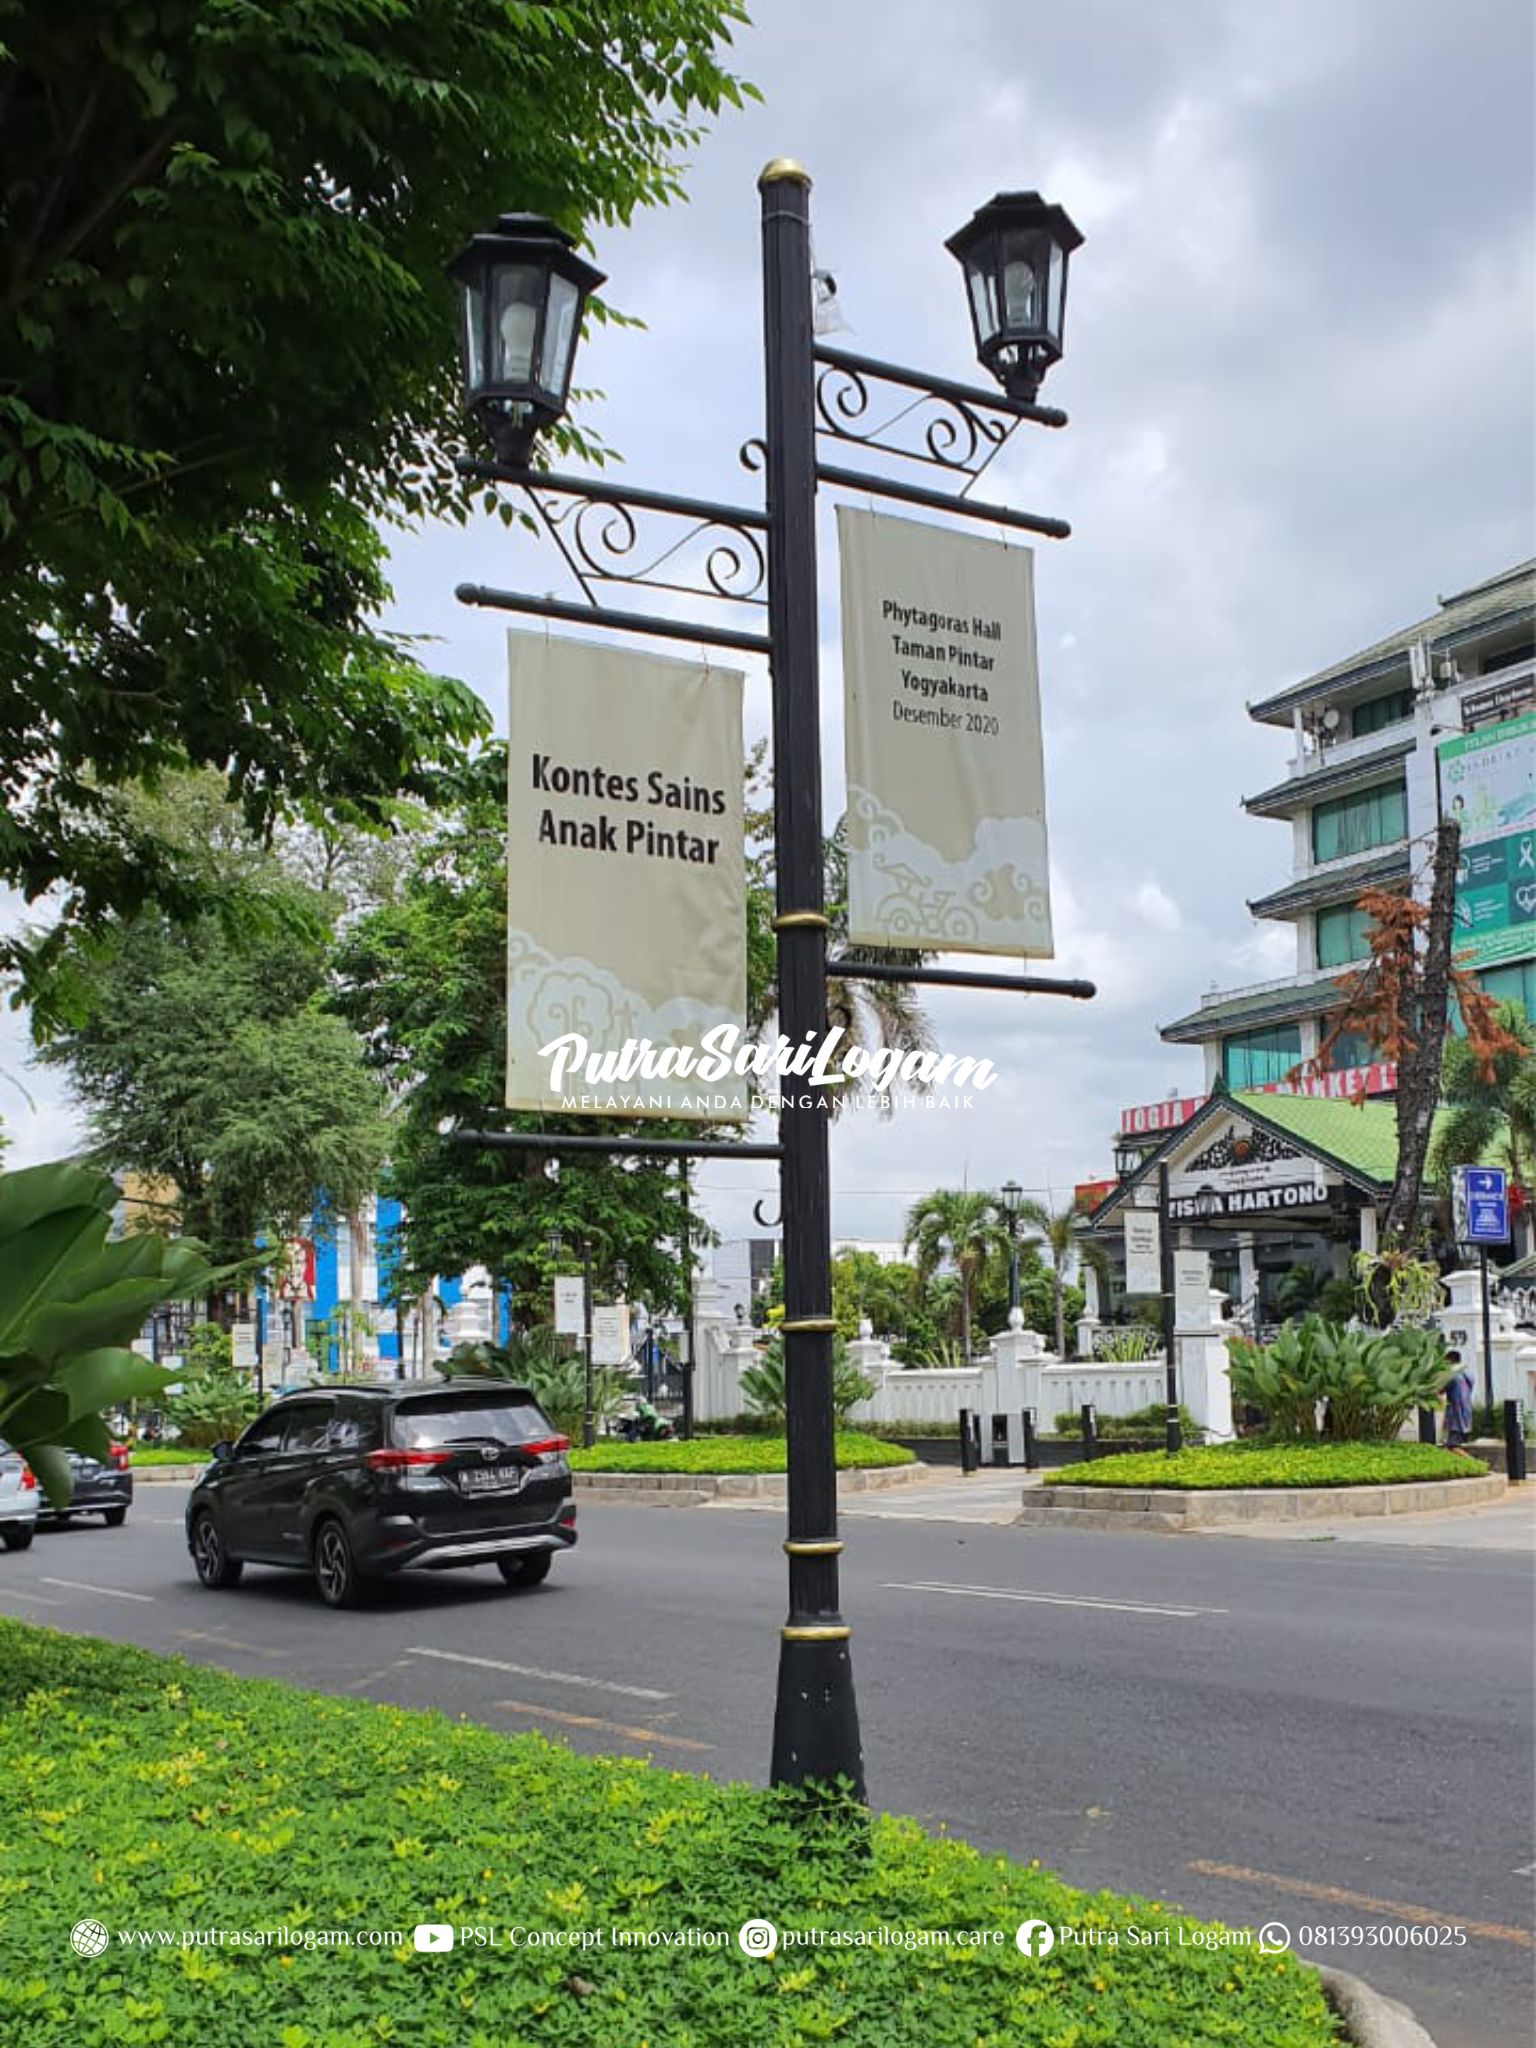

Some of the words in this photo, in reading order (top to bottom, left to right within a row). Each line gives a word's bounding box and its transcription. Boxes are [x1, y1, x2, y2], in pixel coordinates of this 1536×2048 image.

[882, 600, 970, 634] Phytagoras
[972, 617, 1002, 641] Hall
[892, 635, 946, 661] Taman
[948, 645, 996, 673] Pintar
[901, 668, 989, 703] Yogyakarta
[892, 699, 963, 730] Desember
[965, 712, 1000, 736] 2020
[532, 753, 639, 803] Kontes
[647, 770, 727, 816] Sains
[538, 808, 618, 852] Anak
[626, 819, 720, 865] Pintar
[1228, 1184, 1328, 1212] HARTONO
